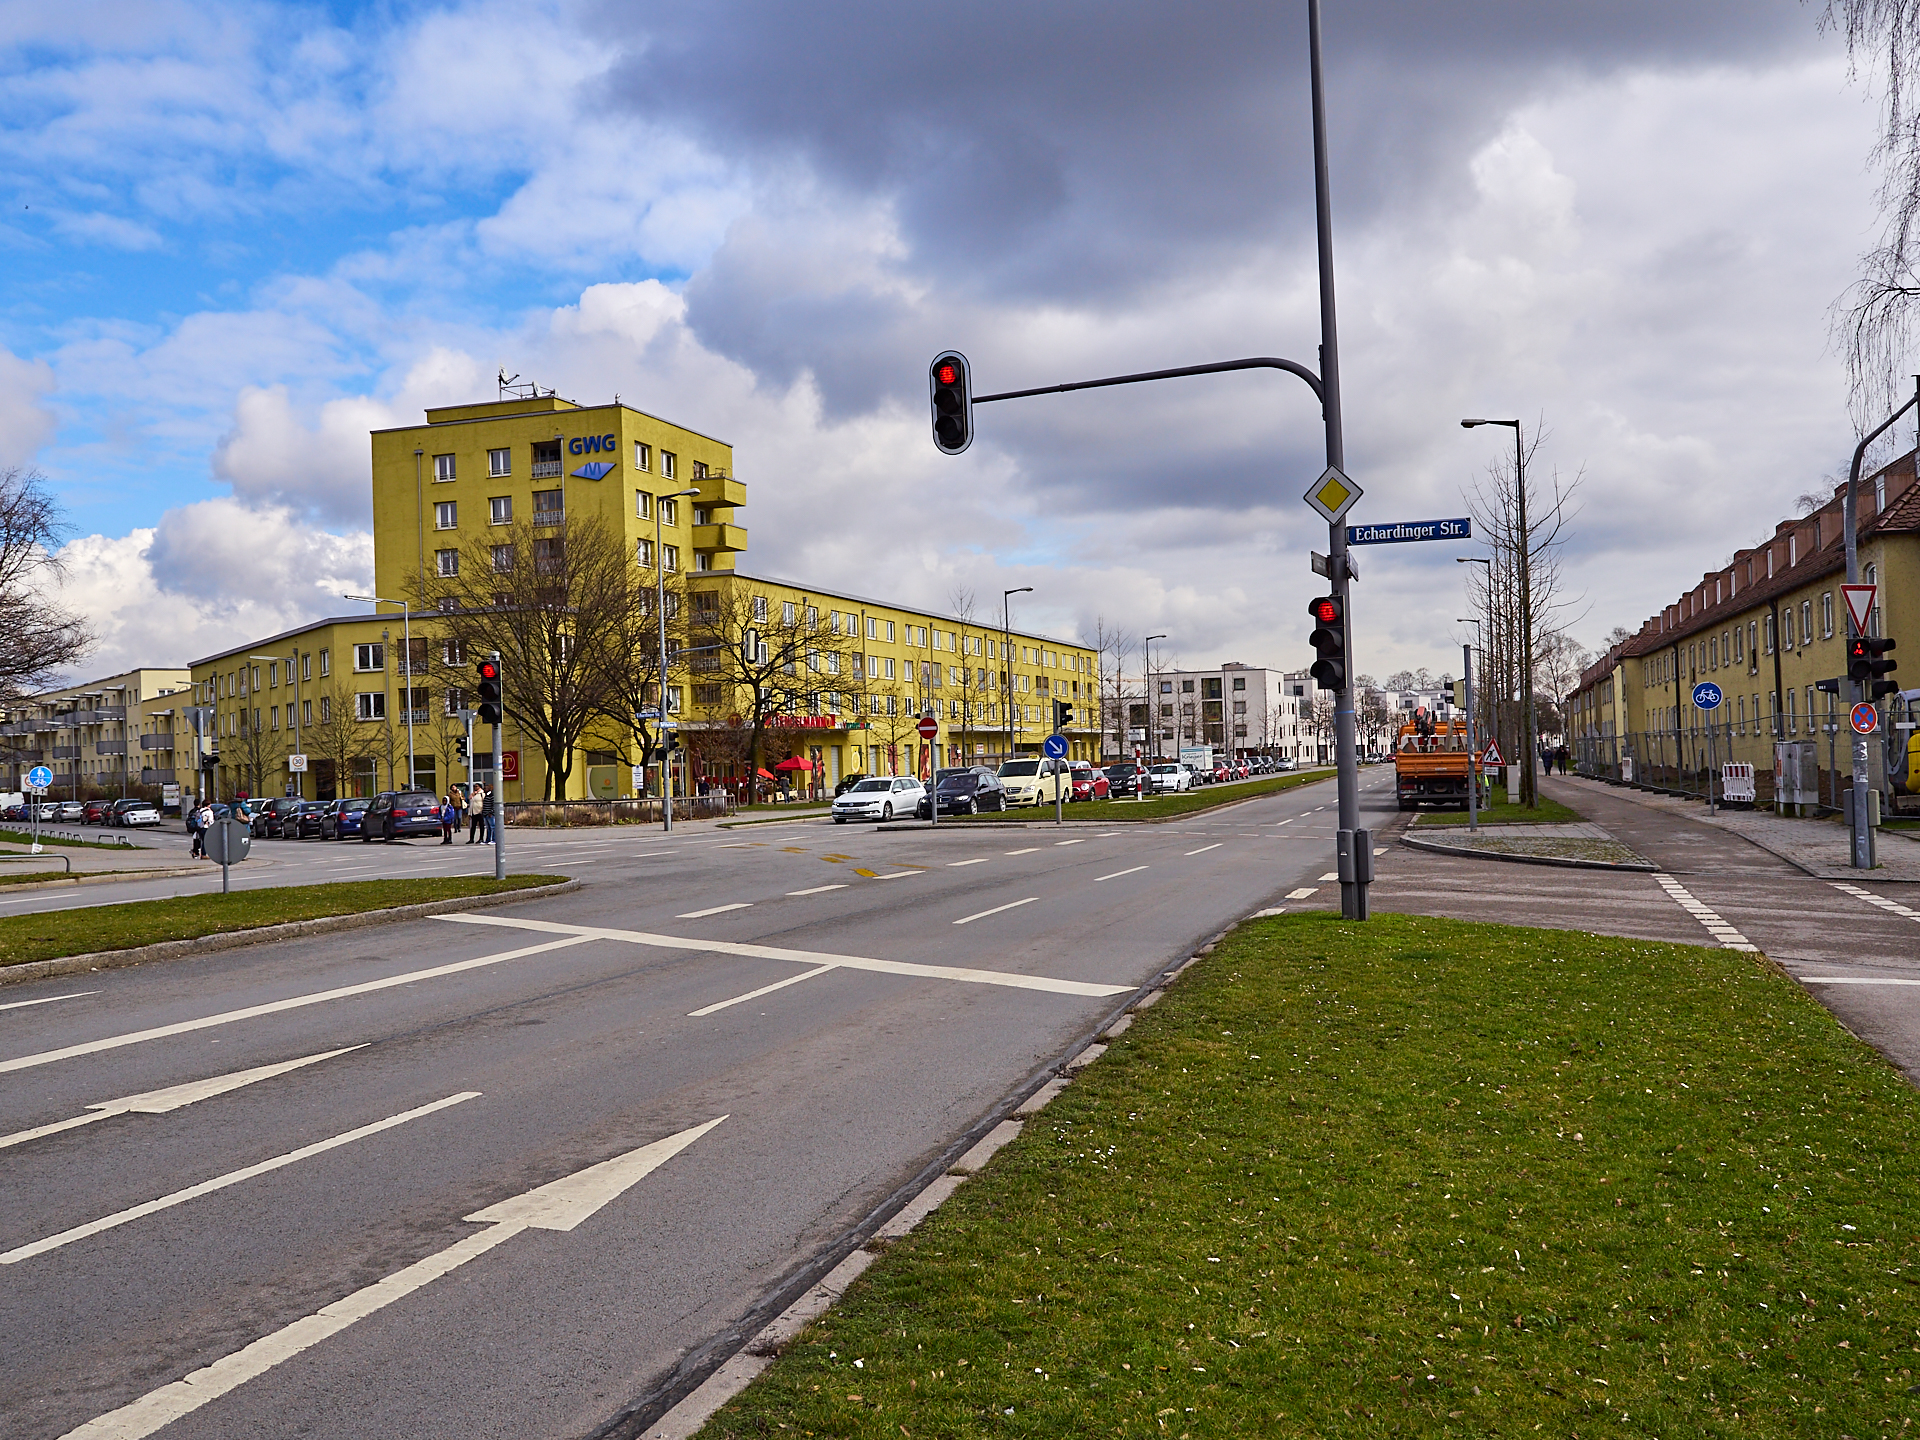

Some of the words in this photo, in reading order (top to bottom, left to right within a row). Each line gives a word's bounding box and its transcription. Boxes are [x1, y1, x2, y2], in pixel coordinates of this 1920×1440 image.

[569, 434, 616, 455] GWG
[1355, 525, 1435, 541] Echardinger
[1440, 521, 1464, 536] Str.
